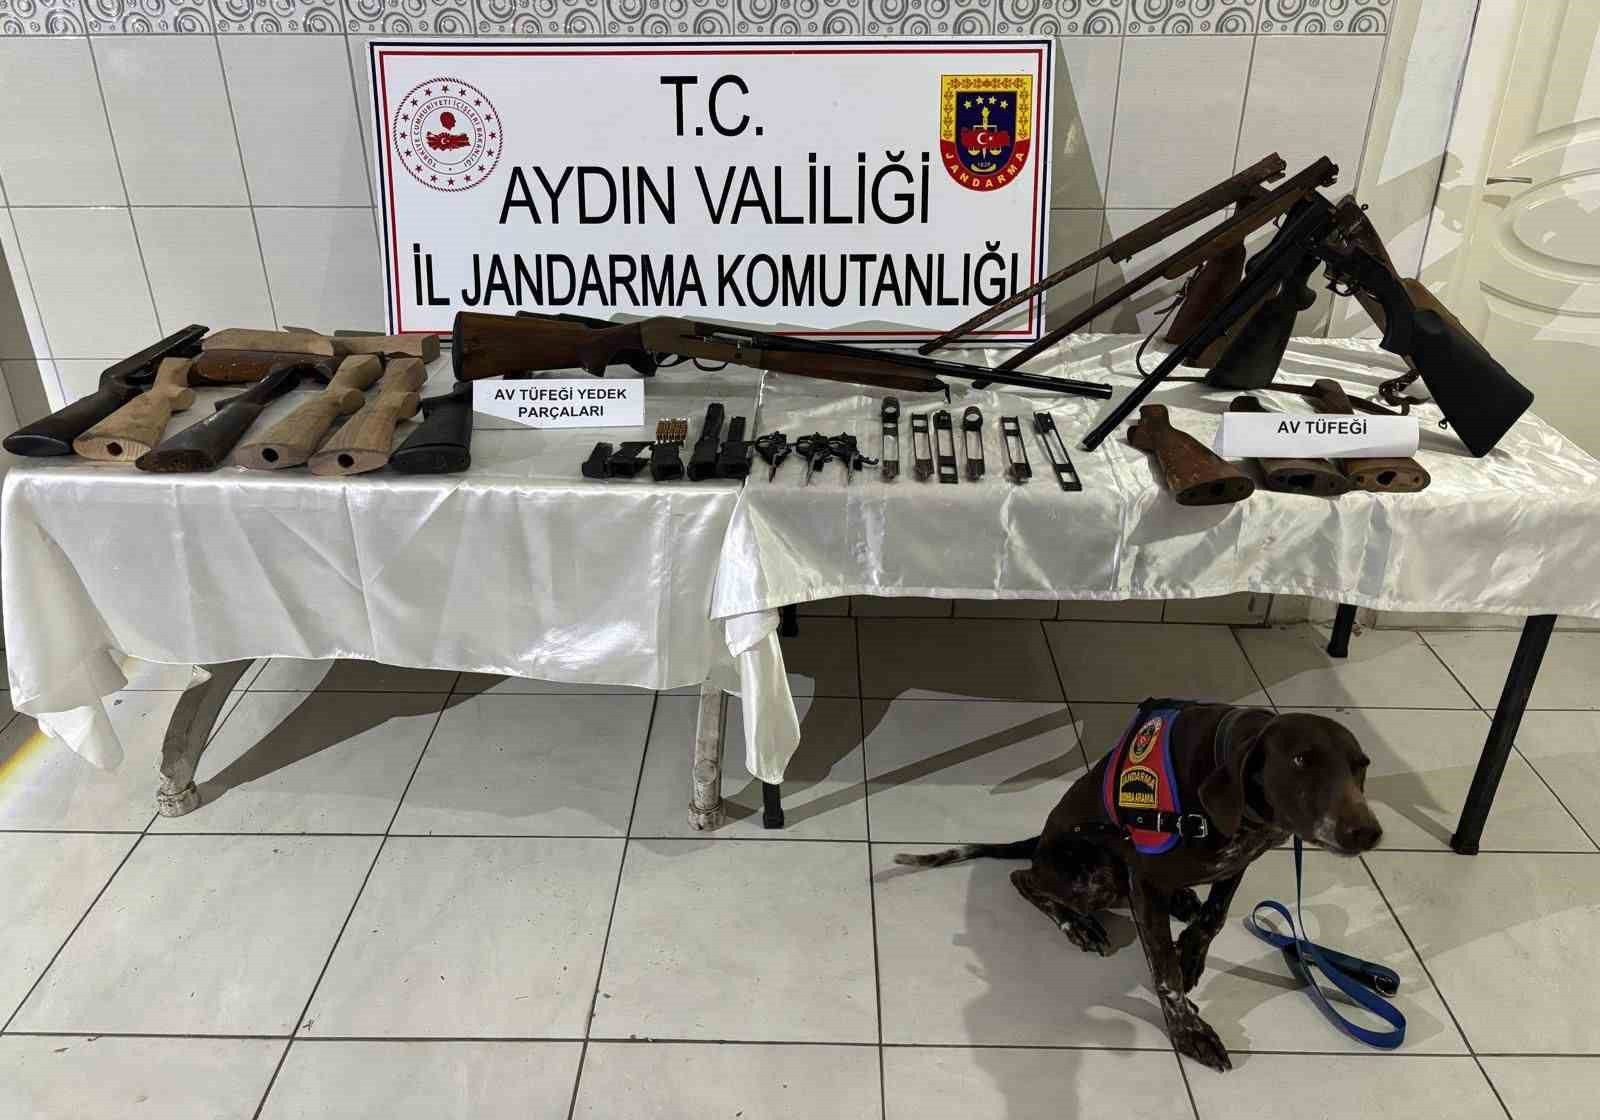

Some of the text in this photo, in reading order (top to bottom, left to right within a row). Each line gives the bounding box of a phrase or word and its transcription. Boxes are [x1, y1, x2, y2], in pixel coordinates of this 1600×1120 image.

[660, 75, 764, 137] T.C.
[499, 150, 930, 225] AYDIN VALİLİĞİ
[945, 153, 1025, 188] JANDARMA
[412, 240, 1019, 307] İL JANDARMA KOMUTANLIĞI
[494, 386, 627, 401] AV TÜFEĞİ YEDEK
[518, 405, 604, 420] PARÇALARI
[1277, 418, 1367, 435] AV TÜFEĞİ
